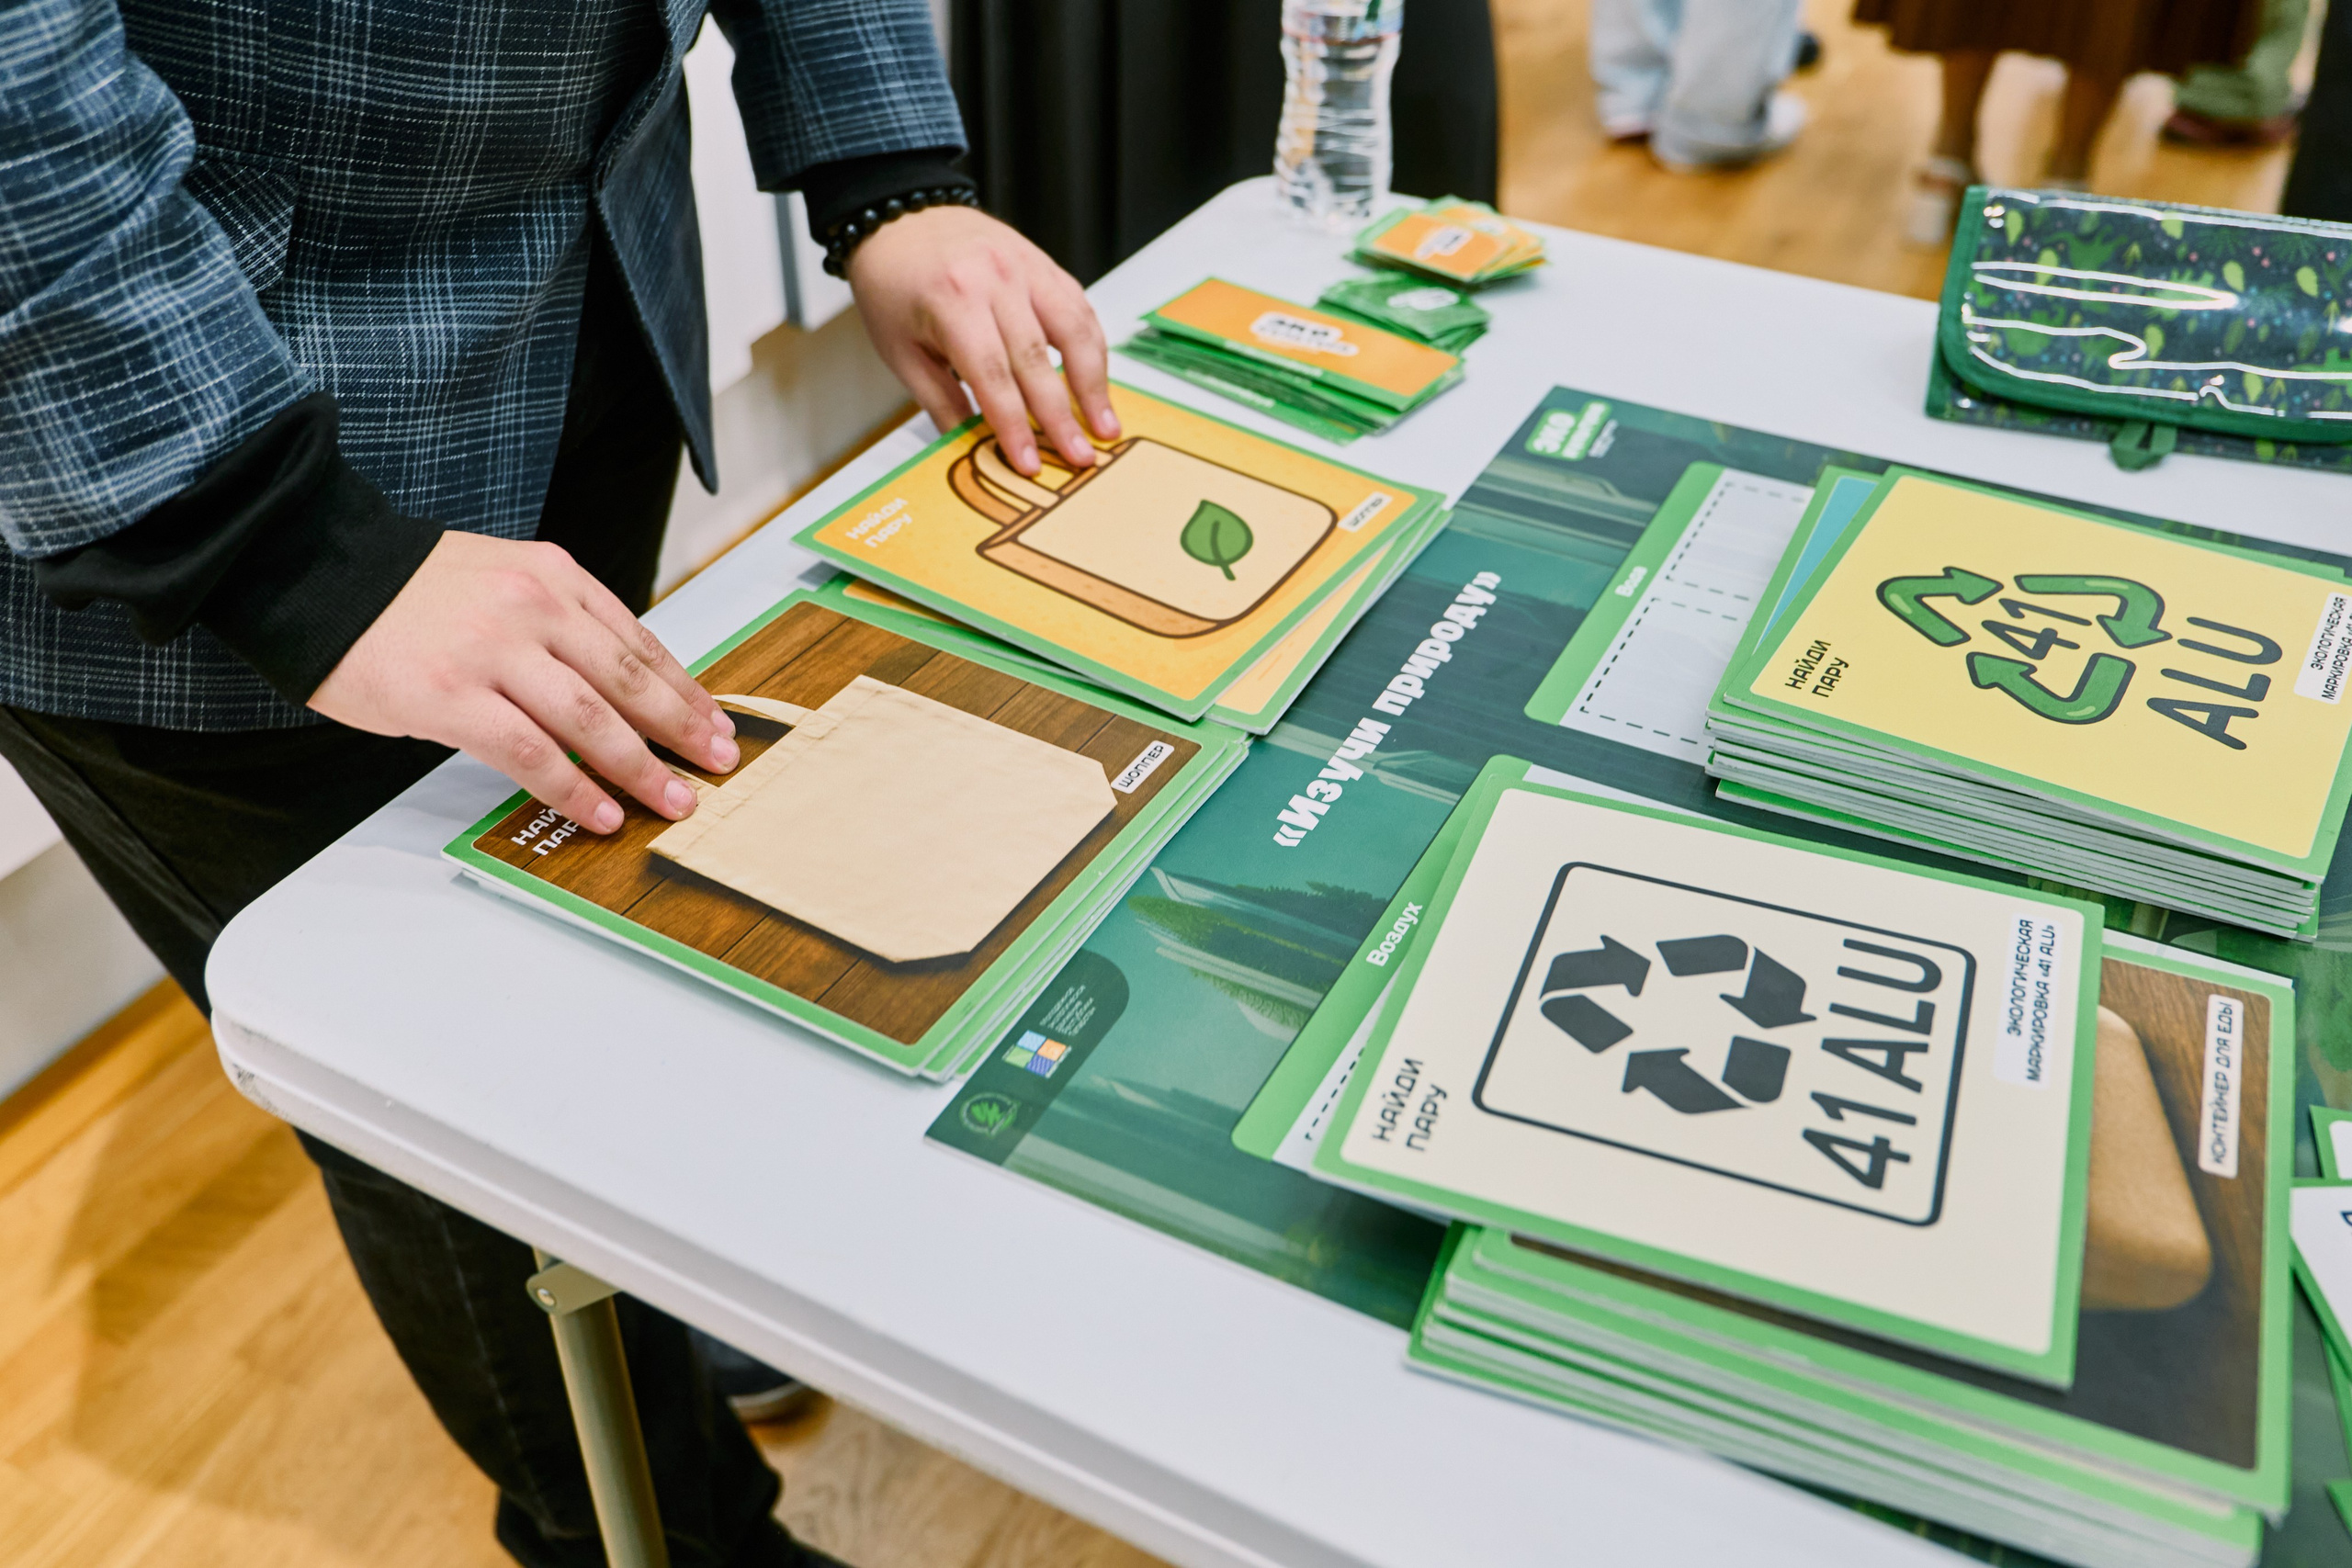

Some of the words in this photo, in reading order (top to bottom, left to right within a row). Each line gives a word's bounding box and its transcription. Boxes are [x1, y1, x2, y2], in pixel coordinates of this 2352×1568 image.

[845, 497, 909, 540] НАЙДИ
[864, 513, 912, 548] ПАРУ
[1981, 598, 2093, 660] 41
[2311, 596, 2347, 671] ЭКОЛОГИЧЕСКАЯ
[1784, 639, 1831, 690] НАЙДИ
[1811, 657, 1849, 697] ПАРУ
[2146, 616, 2283, 750] ALU
[2321, 637, 2352, 701] МАРКИРОВКА
[1273, 717, 1391, 847] «Изучи
[1372, 571, 1501, 716] природу»
[1118, 745, 1164, 788] ШОППЕР
[1365, 901, 1423, 967] Воздух
[2007, 919, 2033, 1036] ЭКОЛОГИЧЕСКАЯ
[2026, 980, 2051, 1082] МАРКИРОВКА
[2039, 924, 2055, 956] ALU»
[1820, 938, 1942, 1094] ALU
[2217, 1002, 2233, 1034] ЕДЫ
[2215, 1037, 2231, 1068] ДЛЯ
[1372, 1057, 1423, 1142] НАЙДИ
[1406, 1084, 1447, 1151] ПАРУ
[2209, 1071, 2230, 1165] КОНТЕЙНЕР
[1802, 1090, 1917, 1190] 41
